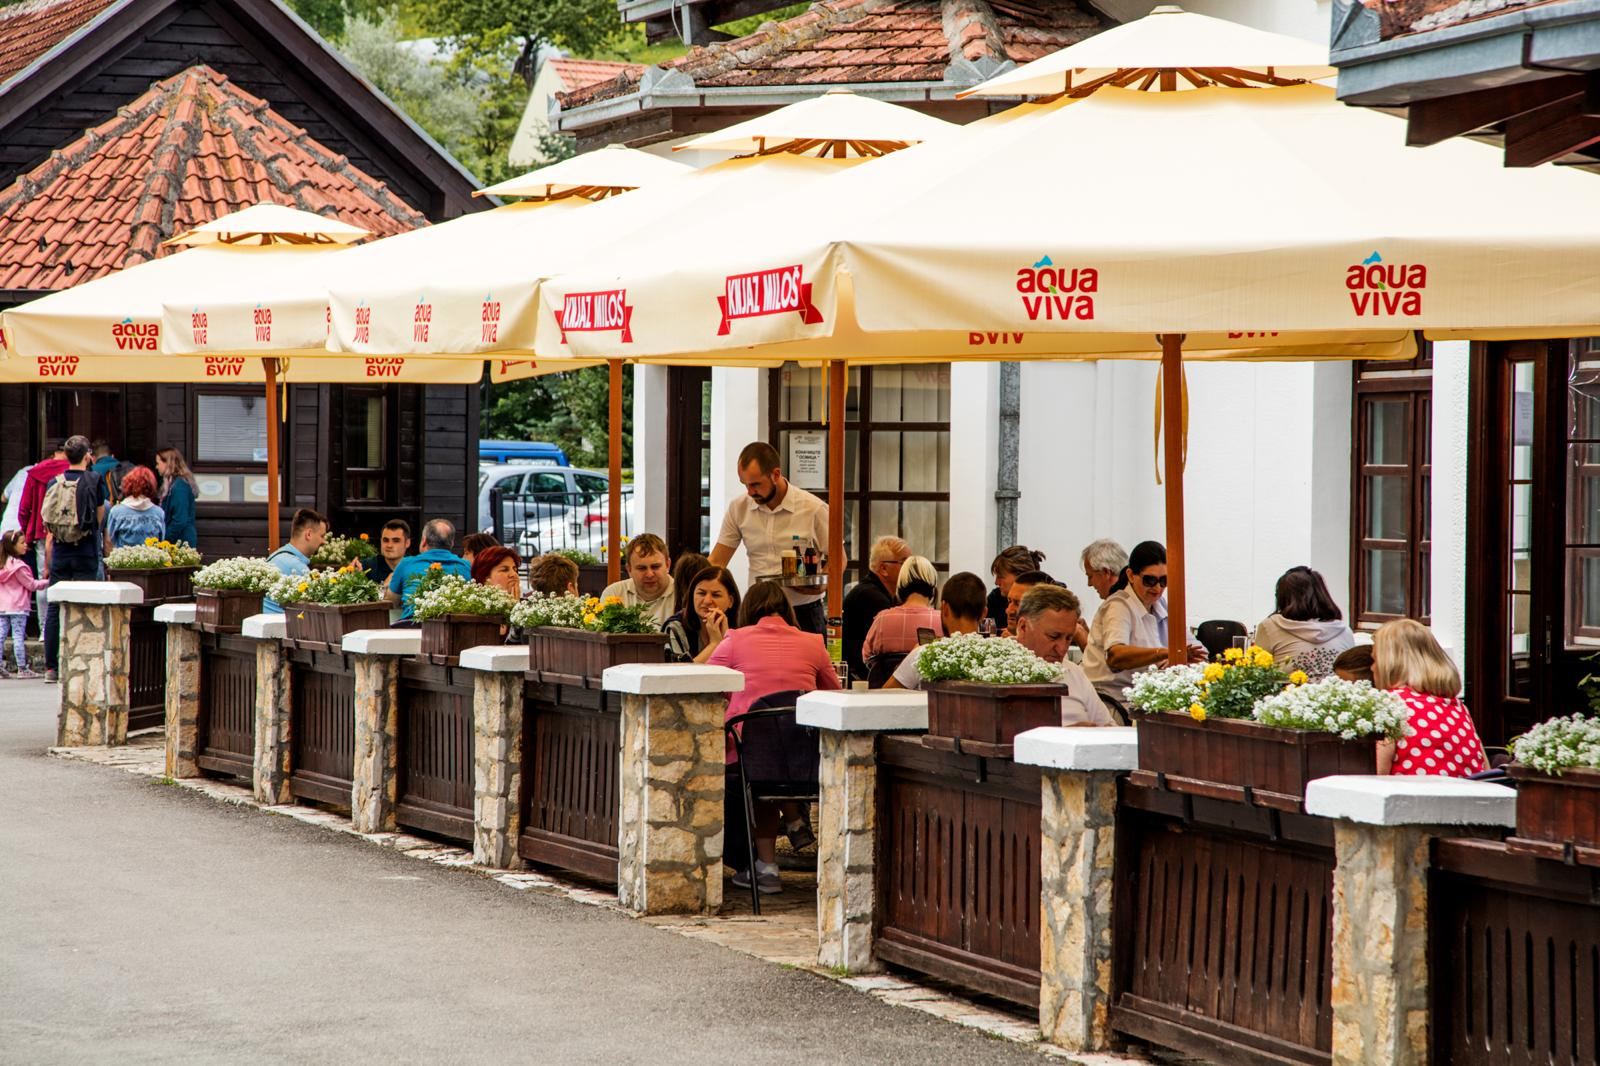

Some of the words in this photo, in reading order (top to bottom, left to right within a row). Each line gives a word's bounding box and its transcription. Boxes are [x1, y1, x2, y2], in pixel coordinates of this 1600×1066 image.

[1016, 268, 1098, 293] aqua
[1346, 264, 1427, 290] aqua
[727, 275, 760, 316] KNJAZ
[763, 266, 801, 311] MILOŠ
[1350, 291, 1422, 316] viva
[1022, 295, 1094, 320] viva
[112, 324, 159, 337] aqua
[115, 337, 157, 350] viva
